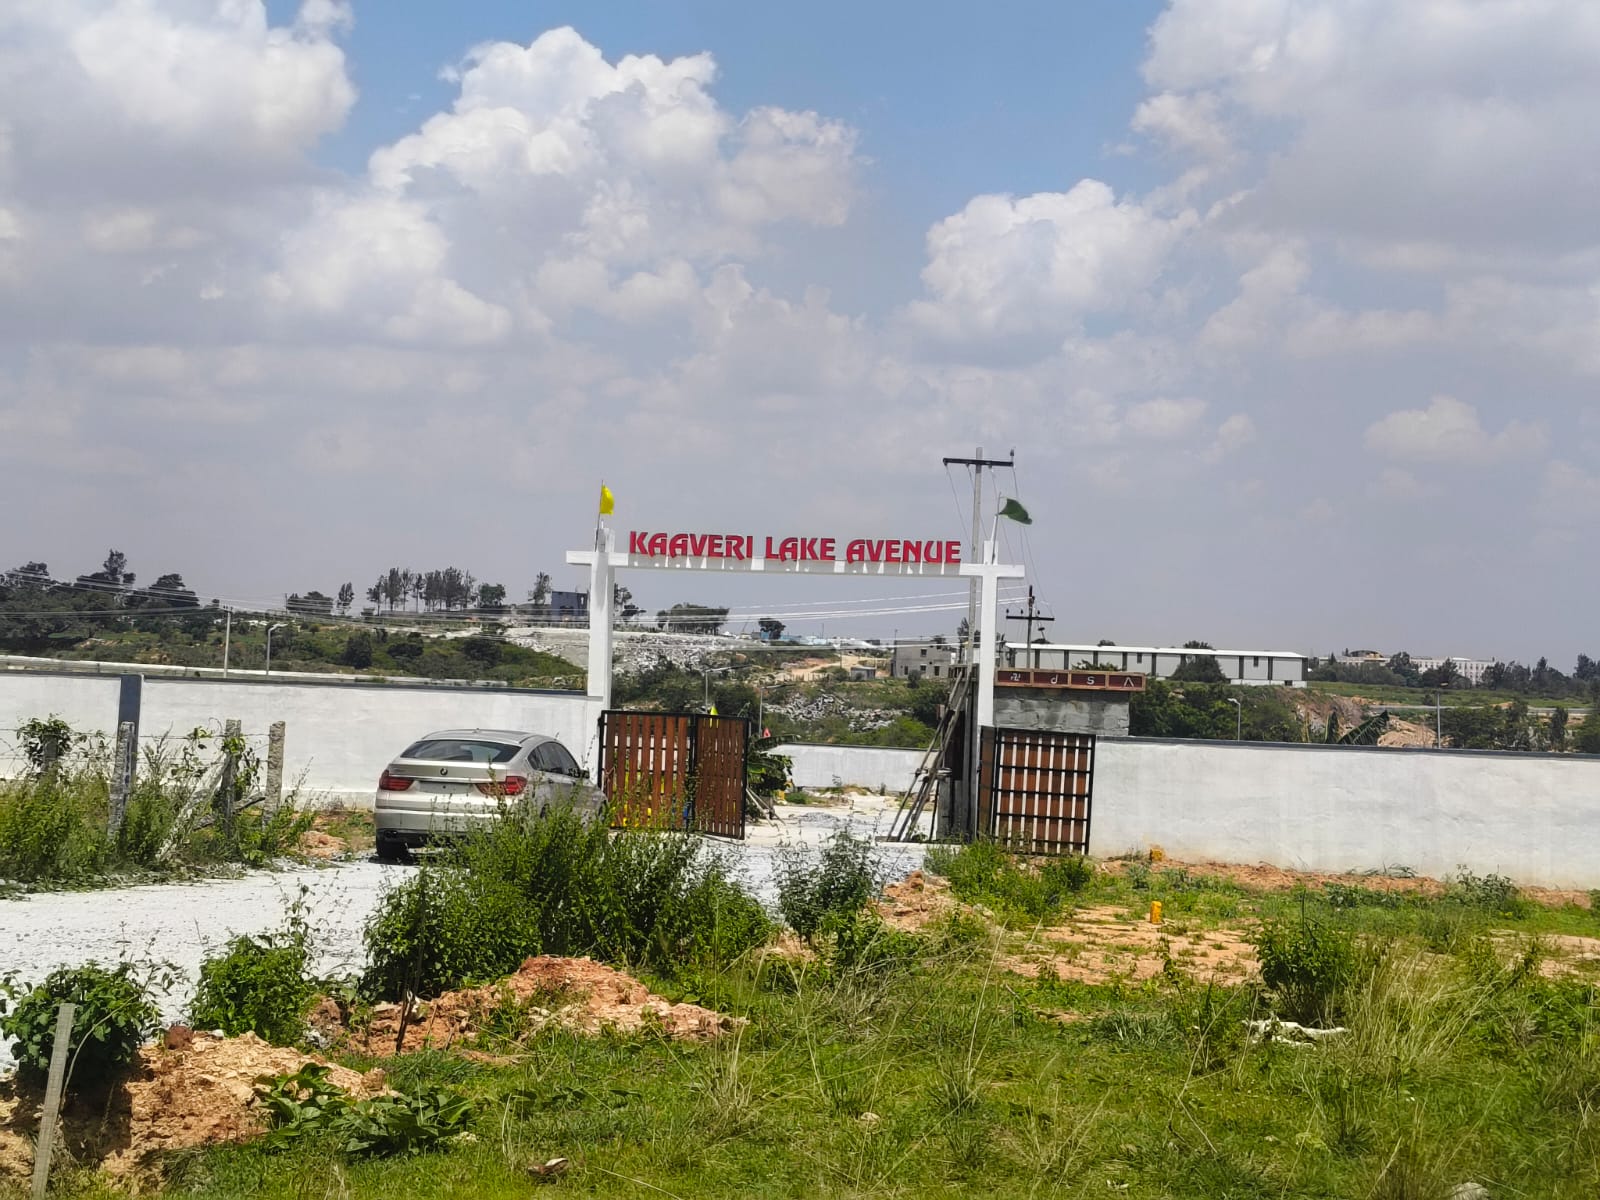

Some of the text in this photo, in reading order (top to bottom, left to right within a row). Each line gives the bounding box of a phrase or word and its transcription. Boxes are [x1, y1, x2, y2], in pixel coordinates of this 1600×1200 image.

[629, 531, 961, 564] KAAVERI LAKE AVENUE
